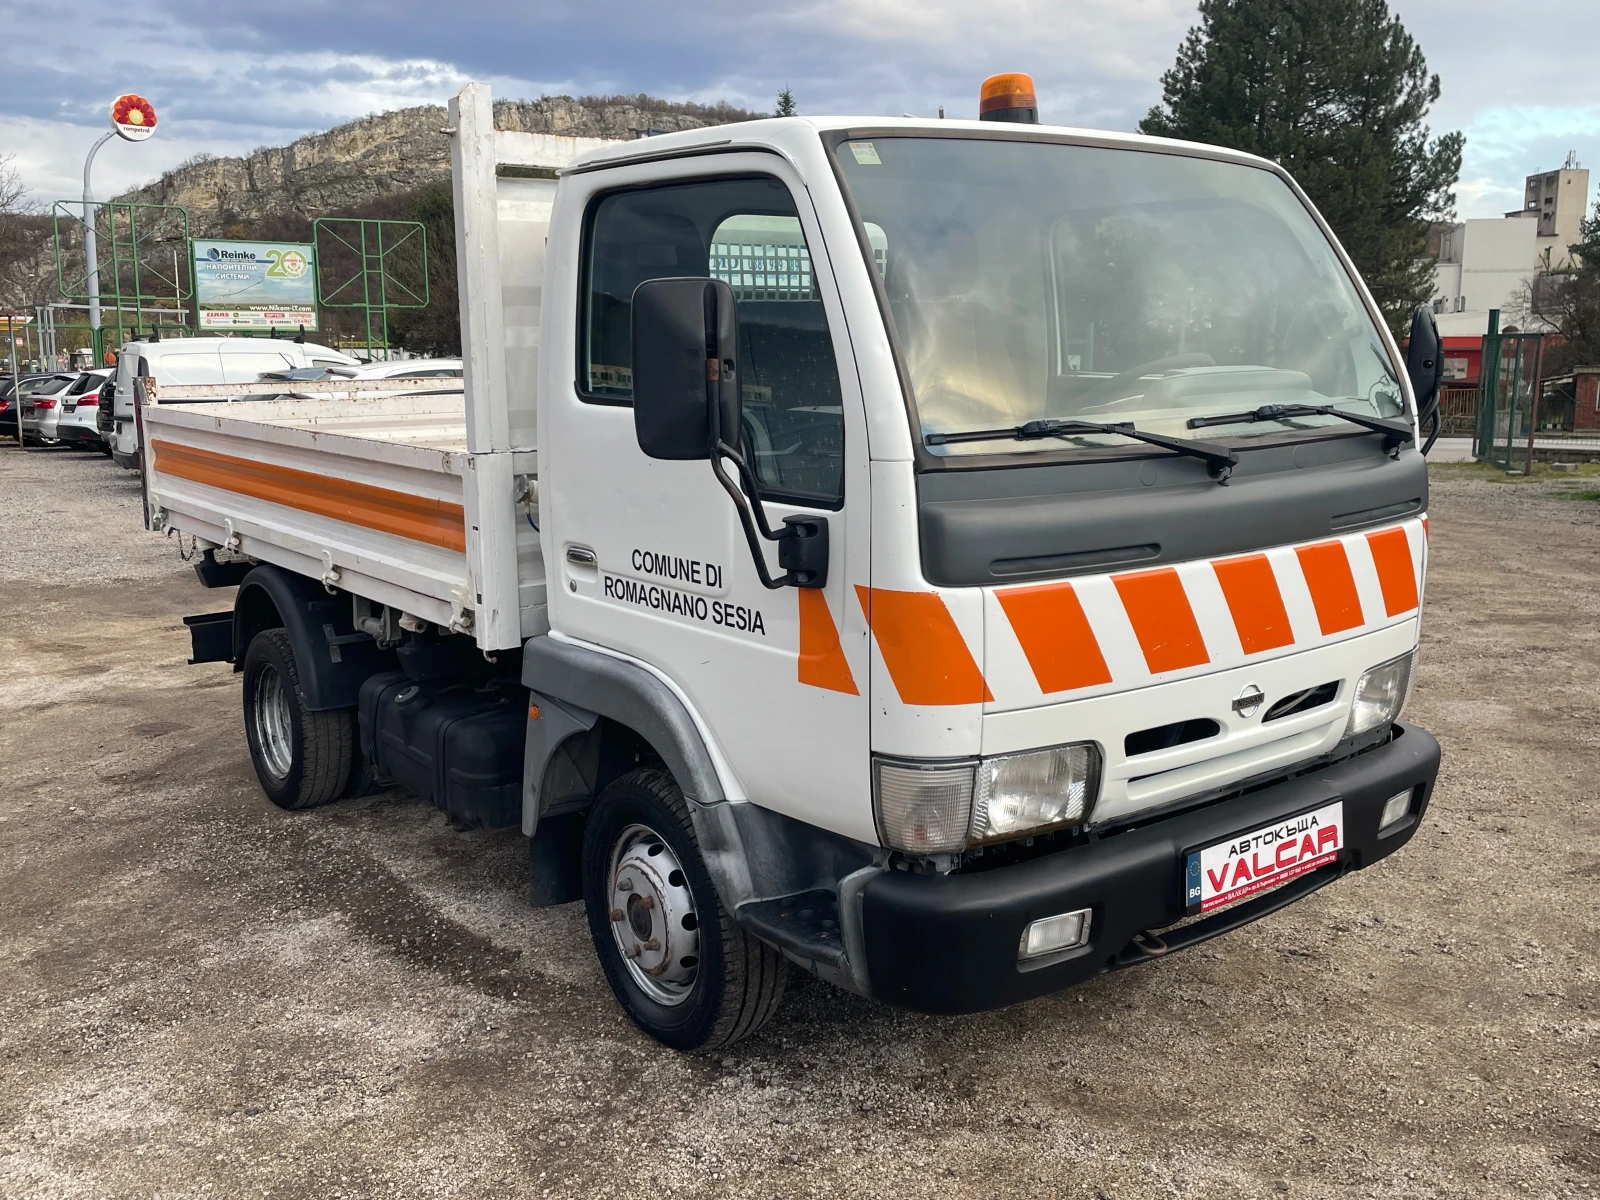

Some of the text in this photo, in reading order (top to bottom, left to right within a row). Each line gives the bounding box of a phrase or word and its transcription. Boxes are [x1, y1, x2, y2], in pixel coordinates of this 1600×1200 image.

[220, 250, 256, 260] Reinke
[206, 263, 258, 271] НАПОИТЕЛНИ
[265, 249, 307, 277] 20
[249, 304, 312, 312] www.Nikom-LT.com
[632, 548, 722, 588] COMUNE DI
[604, 575, 766, 635] ROMAGNANO SESIA
[1237, 694, 1263, 708] NISSAN
[1206, 824, 1338, 893] VALCAR
[1189, 886, 1201, 899] BG
